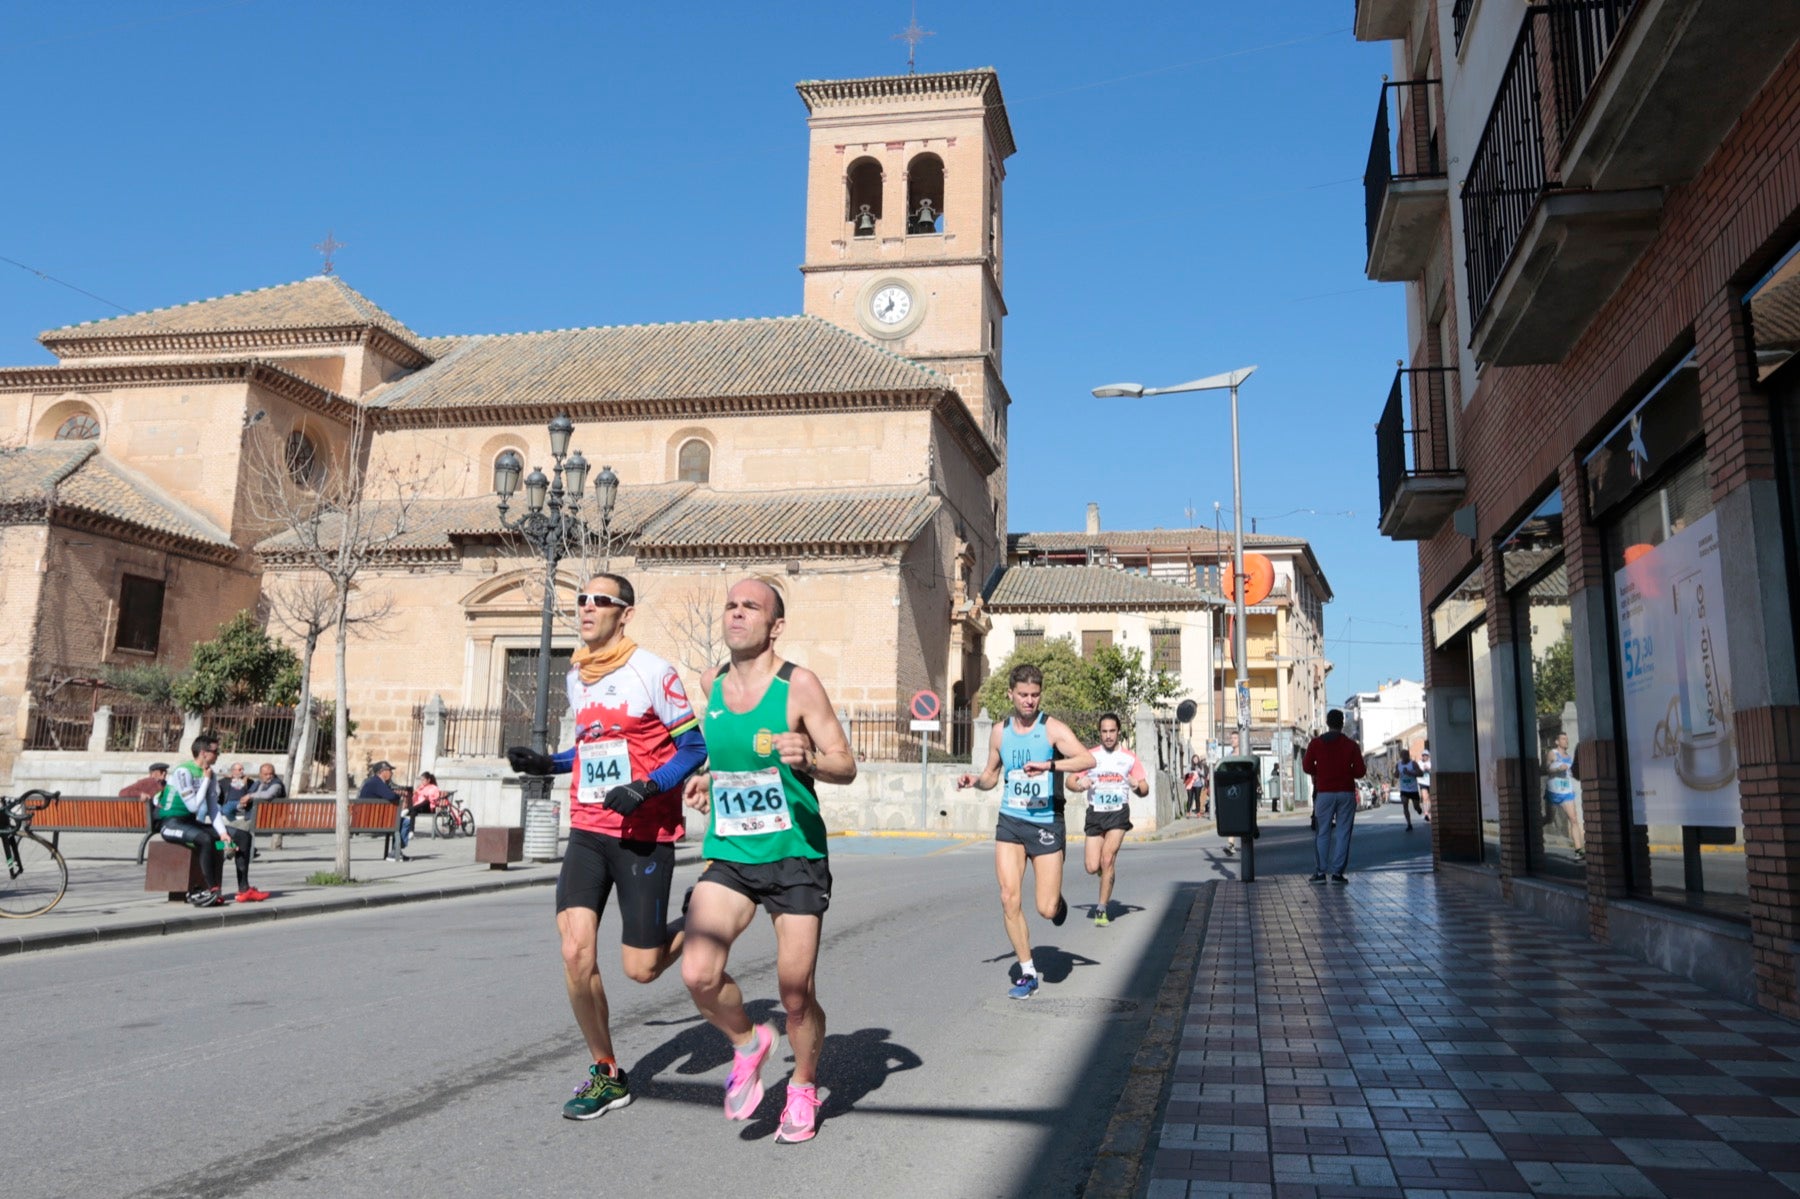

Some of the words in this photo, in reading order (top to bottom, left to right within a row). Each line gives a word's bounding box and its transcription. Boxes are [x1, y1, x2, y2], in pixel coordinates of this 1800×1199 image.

[587, 759, 621, 783] 944
[1014, 782, 1041, 797] 640
[1099, 794, 1118, 804] 124
[719, 787, 783, 814] 1126
